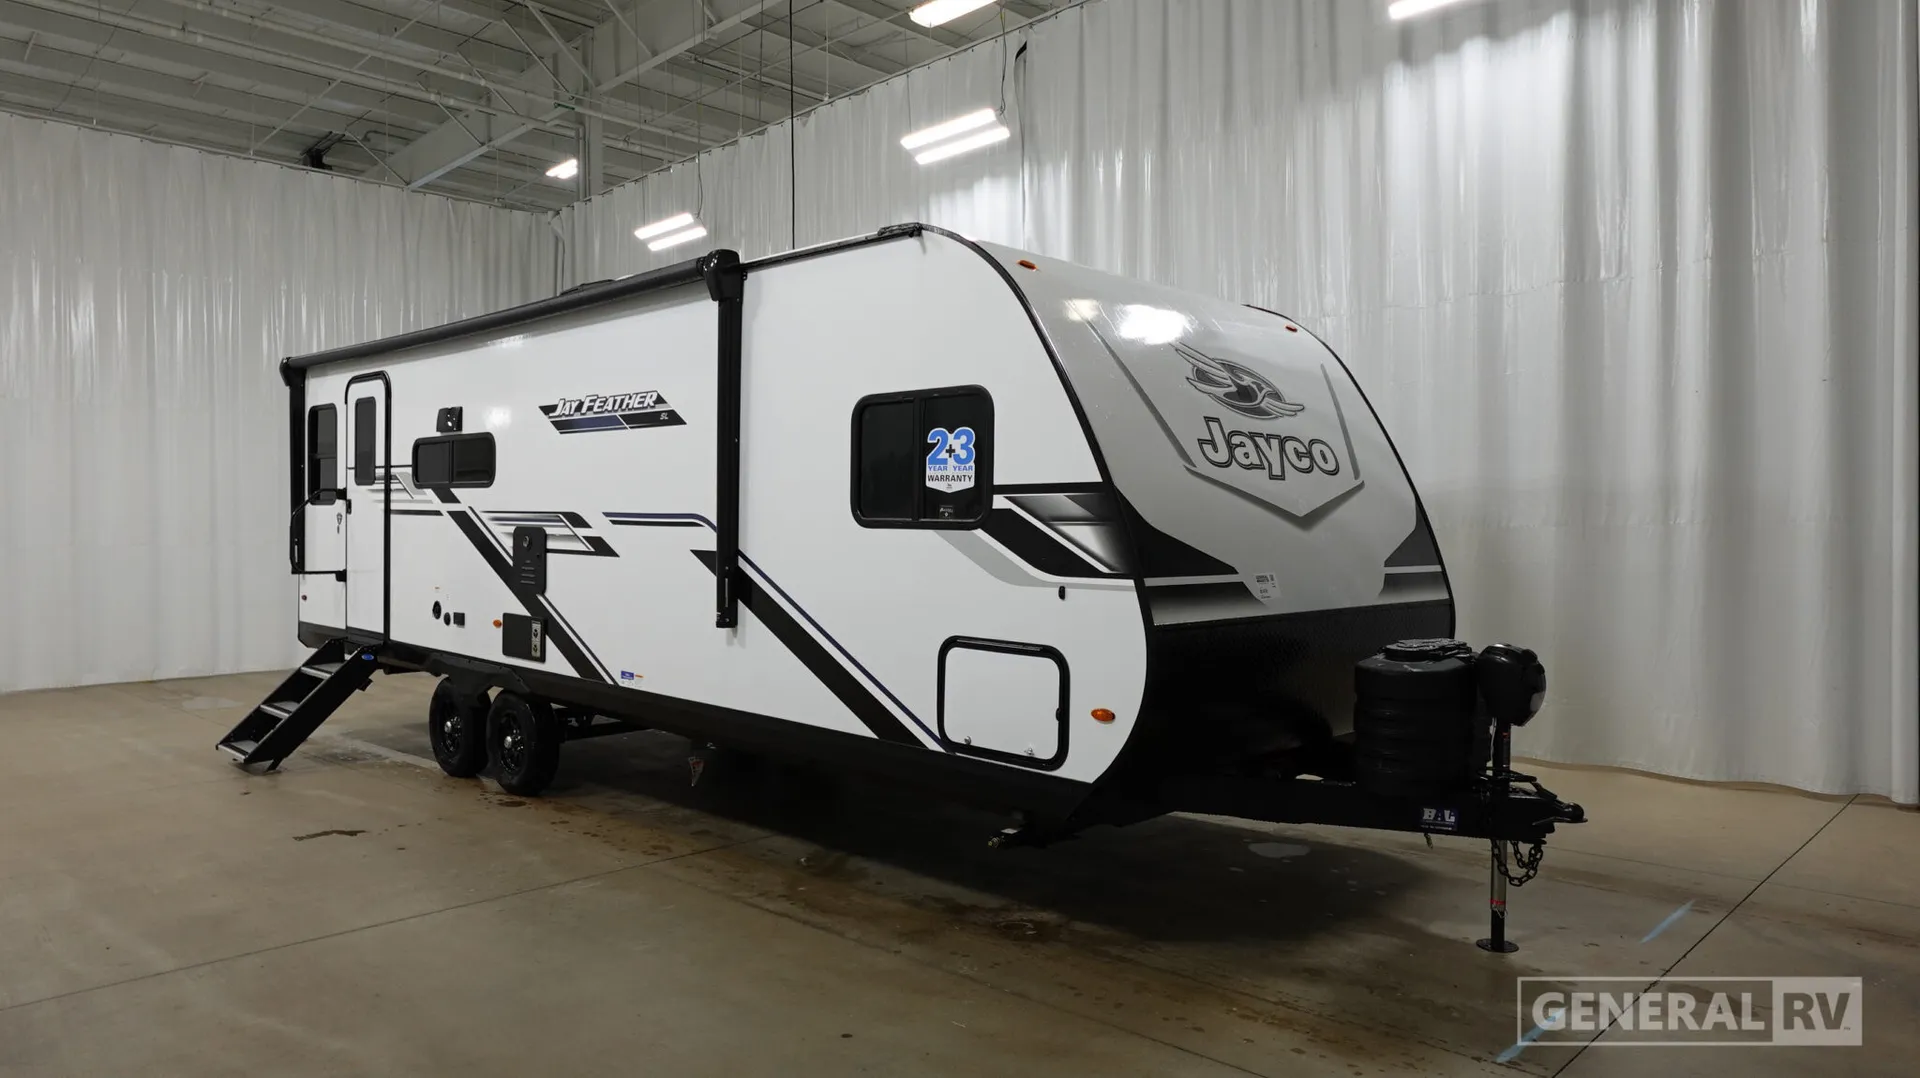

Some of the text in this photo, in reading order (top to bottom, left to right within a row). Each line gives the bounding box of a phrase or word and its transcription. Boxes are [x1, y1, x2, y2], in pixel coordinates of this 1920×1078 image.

[549, 390, 658, 418] JAY FEATHER
[1197, 416, 1340, 481] Jayco
[927, 474, 973, 483] WARRANTY
